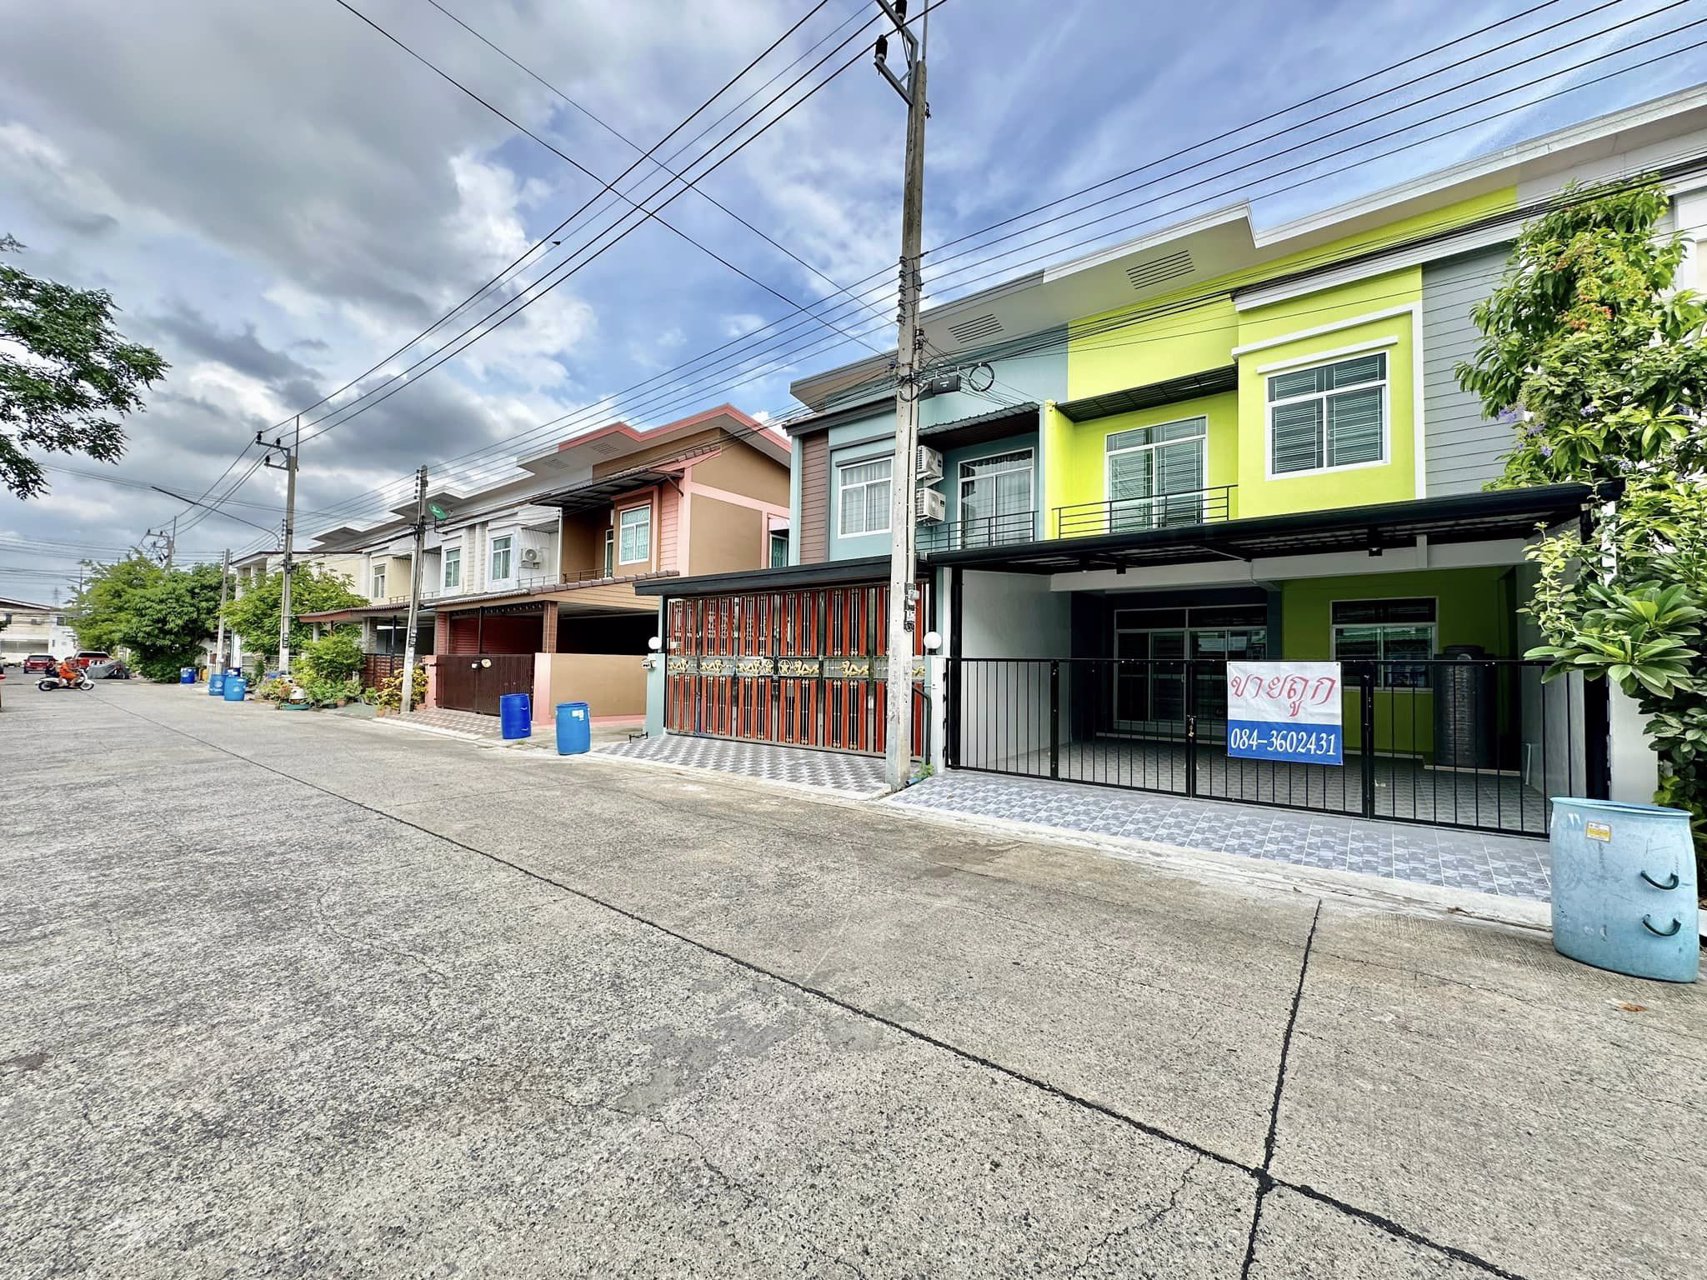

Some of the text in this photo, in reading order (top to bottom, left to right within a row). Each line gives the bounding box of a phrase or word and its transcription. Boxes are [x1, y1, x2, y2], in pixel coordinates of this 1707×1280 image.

[1231, 673, 1337, 717] ขายถูก
[1230, 728, 1337, 756] 084-3602431
